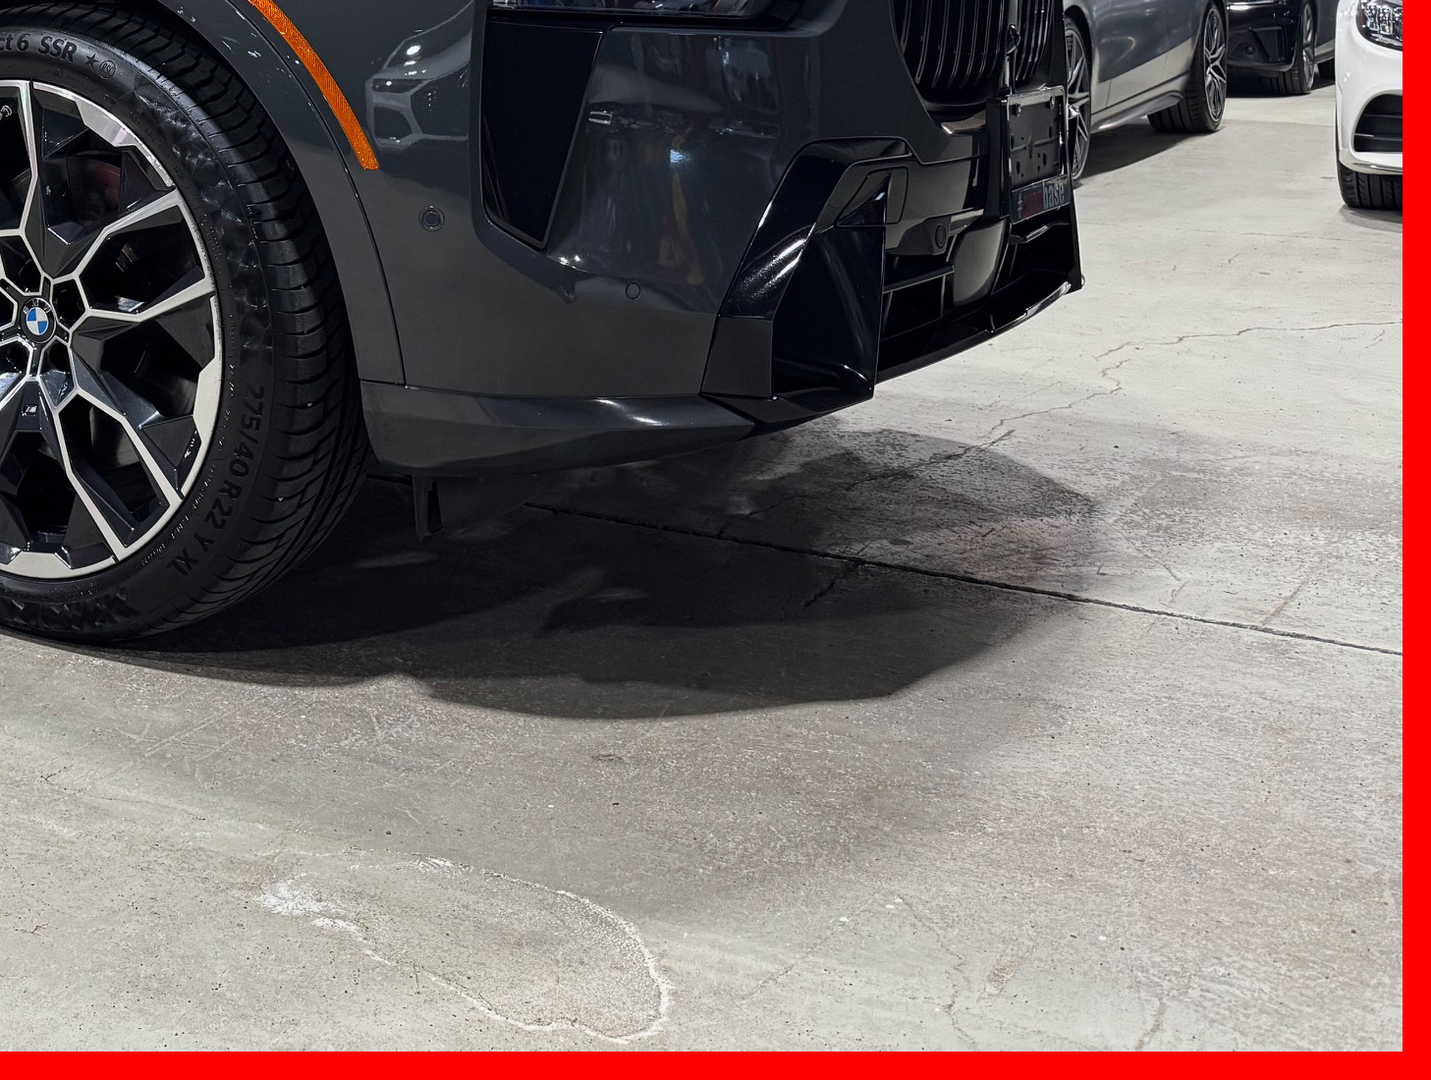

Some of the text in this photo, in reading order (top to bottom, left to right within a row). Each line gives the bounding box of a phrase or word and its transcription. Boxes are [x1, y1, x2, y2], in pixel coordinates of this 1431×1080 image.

[16, 33, 30, 53] 6
[37, 36, 77, 63] SSR
[22, 299, 51, 316] BMW
[229, 384, 265, 478] 275/40
[193, 532, 215, 552] Y
[166, 547, 199, 576] XL
